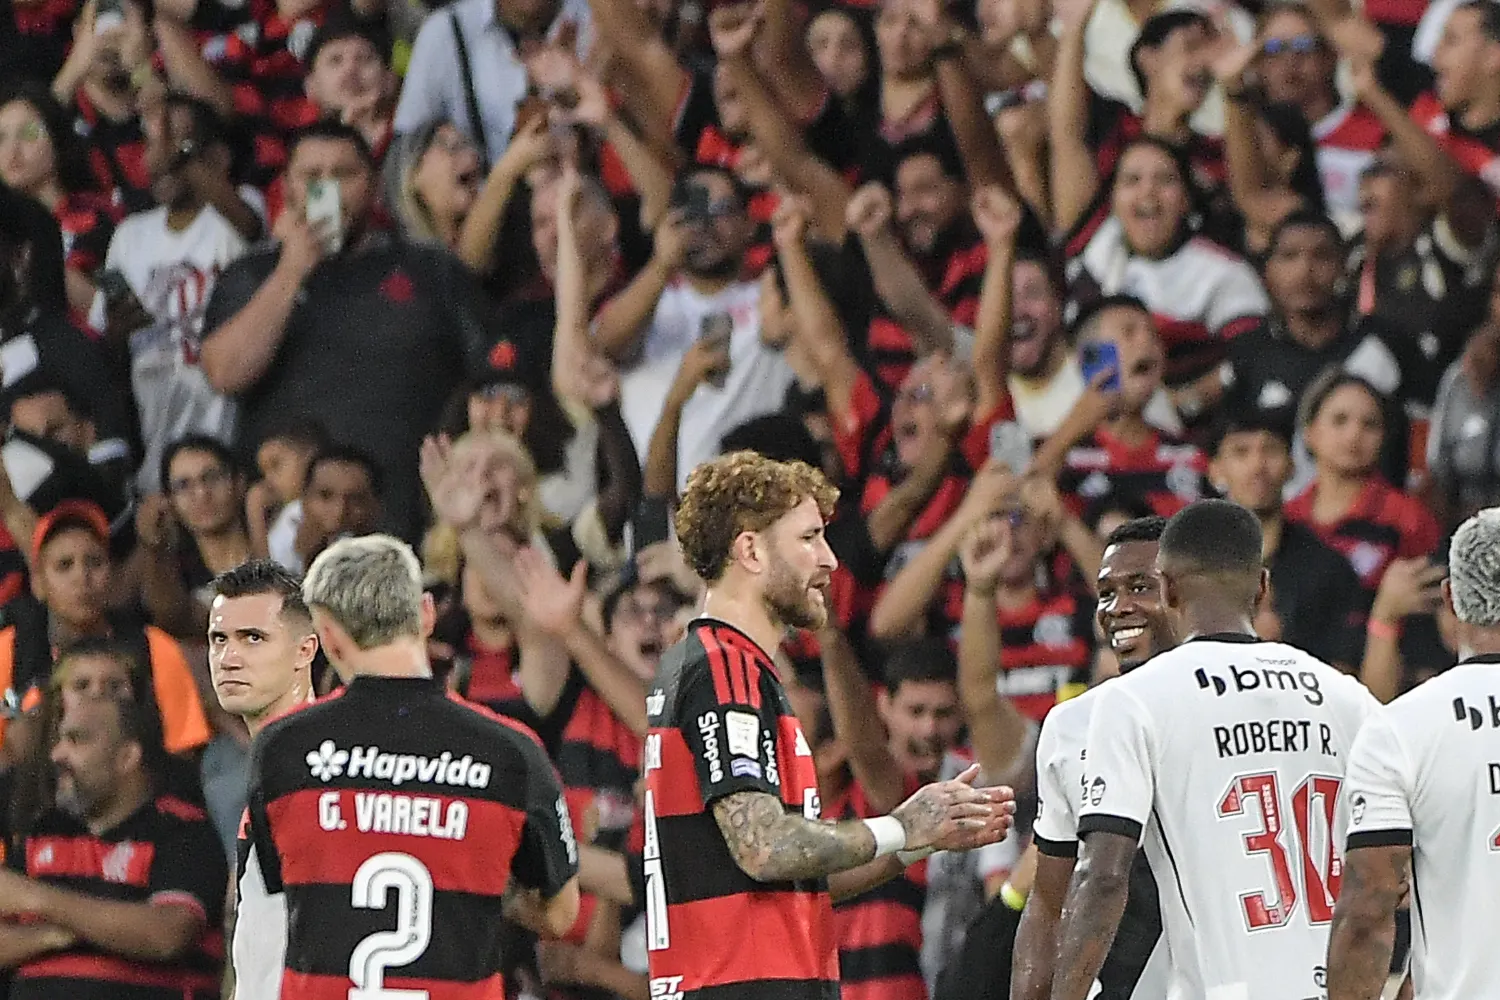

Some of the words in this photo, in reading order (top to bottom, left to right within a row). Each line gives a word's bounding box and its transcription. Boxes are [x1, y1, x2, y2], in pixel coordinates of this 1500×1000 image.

[1229, 665, 1324, 706] bmg
[698, 711, 724, 784] Shopee
[1214, 720, 1311, 758] ROBERT
[1320, 723, 1337, 757] R.
[347, 745, 492, 789] Hapvida
[318, 790, 348, 832] G.
[354, 791, 469, 841] VARELA
[1214, 769, 1344, 934] 30
